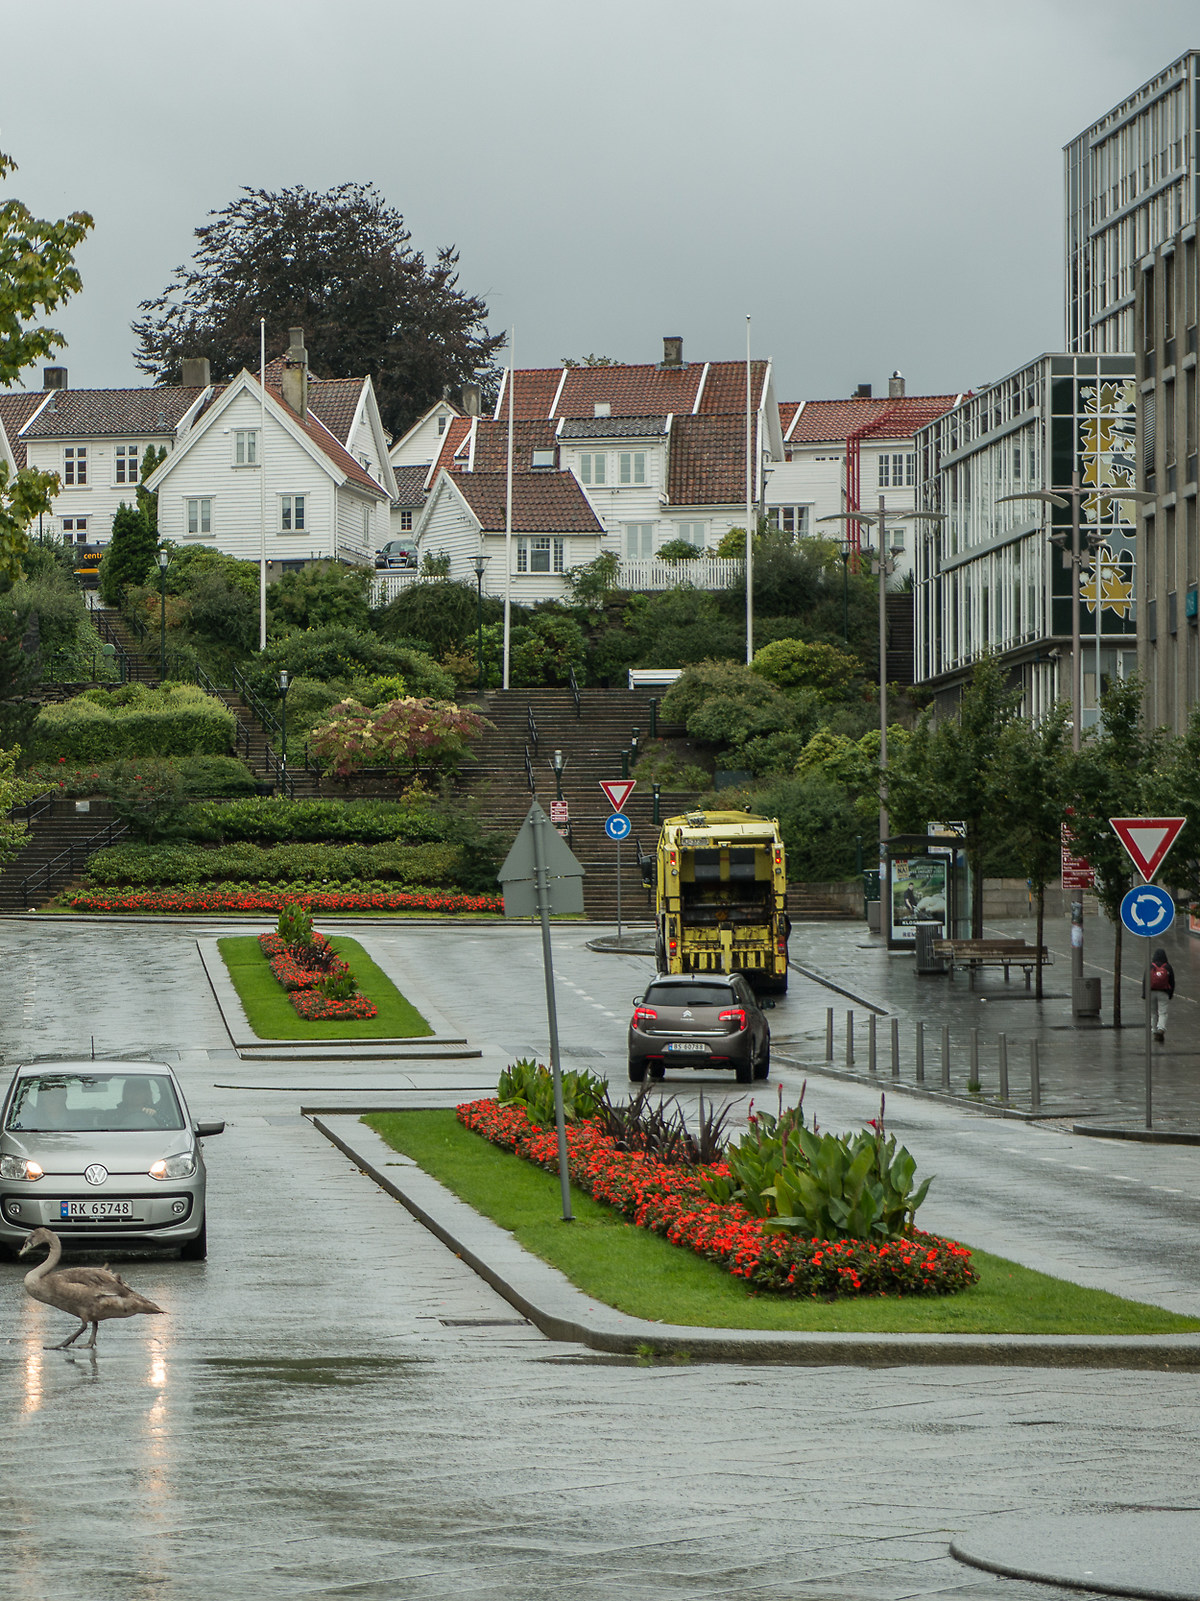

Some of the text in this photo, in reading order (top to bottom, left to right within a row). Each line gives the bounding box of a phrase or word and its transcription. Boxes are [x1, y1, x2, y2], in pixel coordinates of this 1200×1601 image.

[83, 552, 104, 560] centr
[70, 1203, 86, 1214] RK
[91, 1203, 129, 1214] 65748
